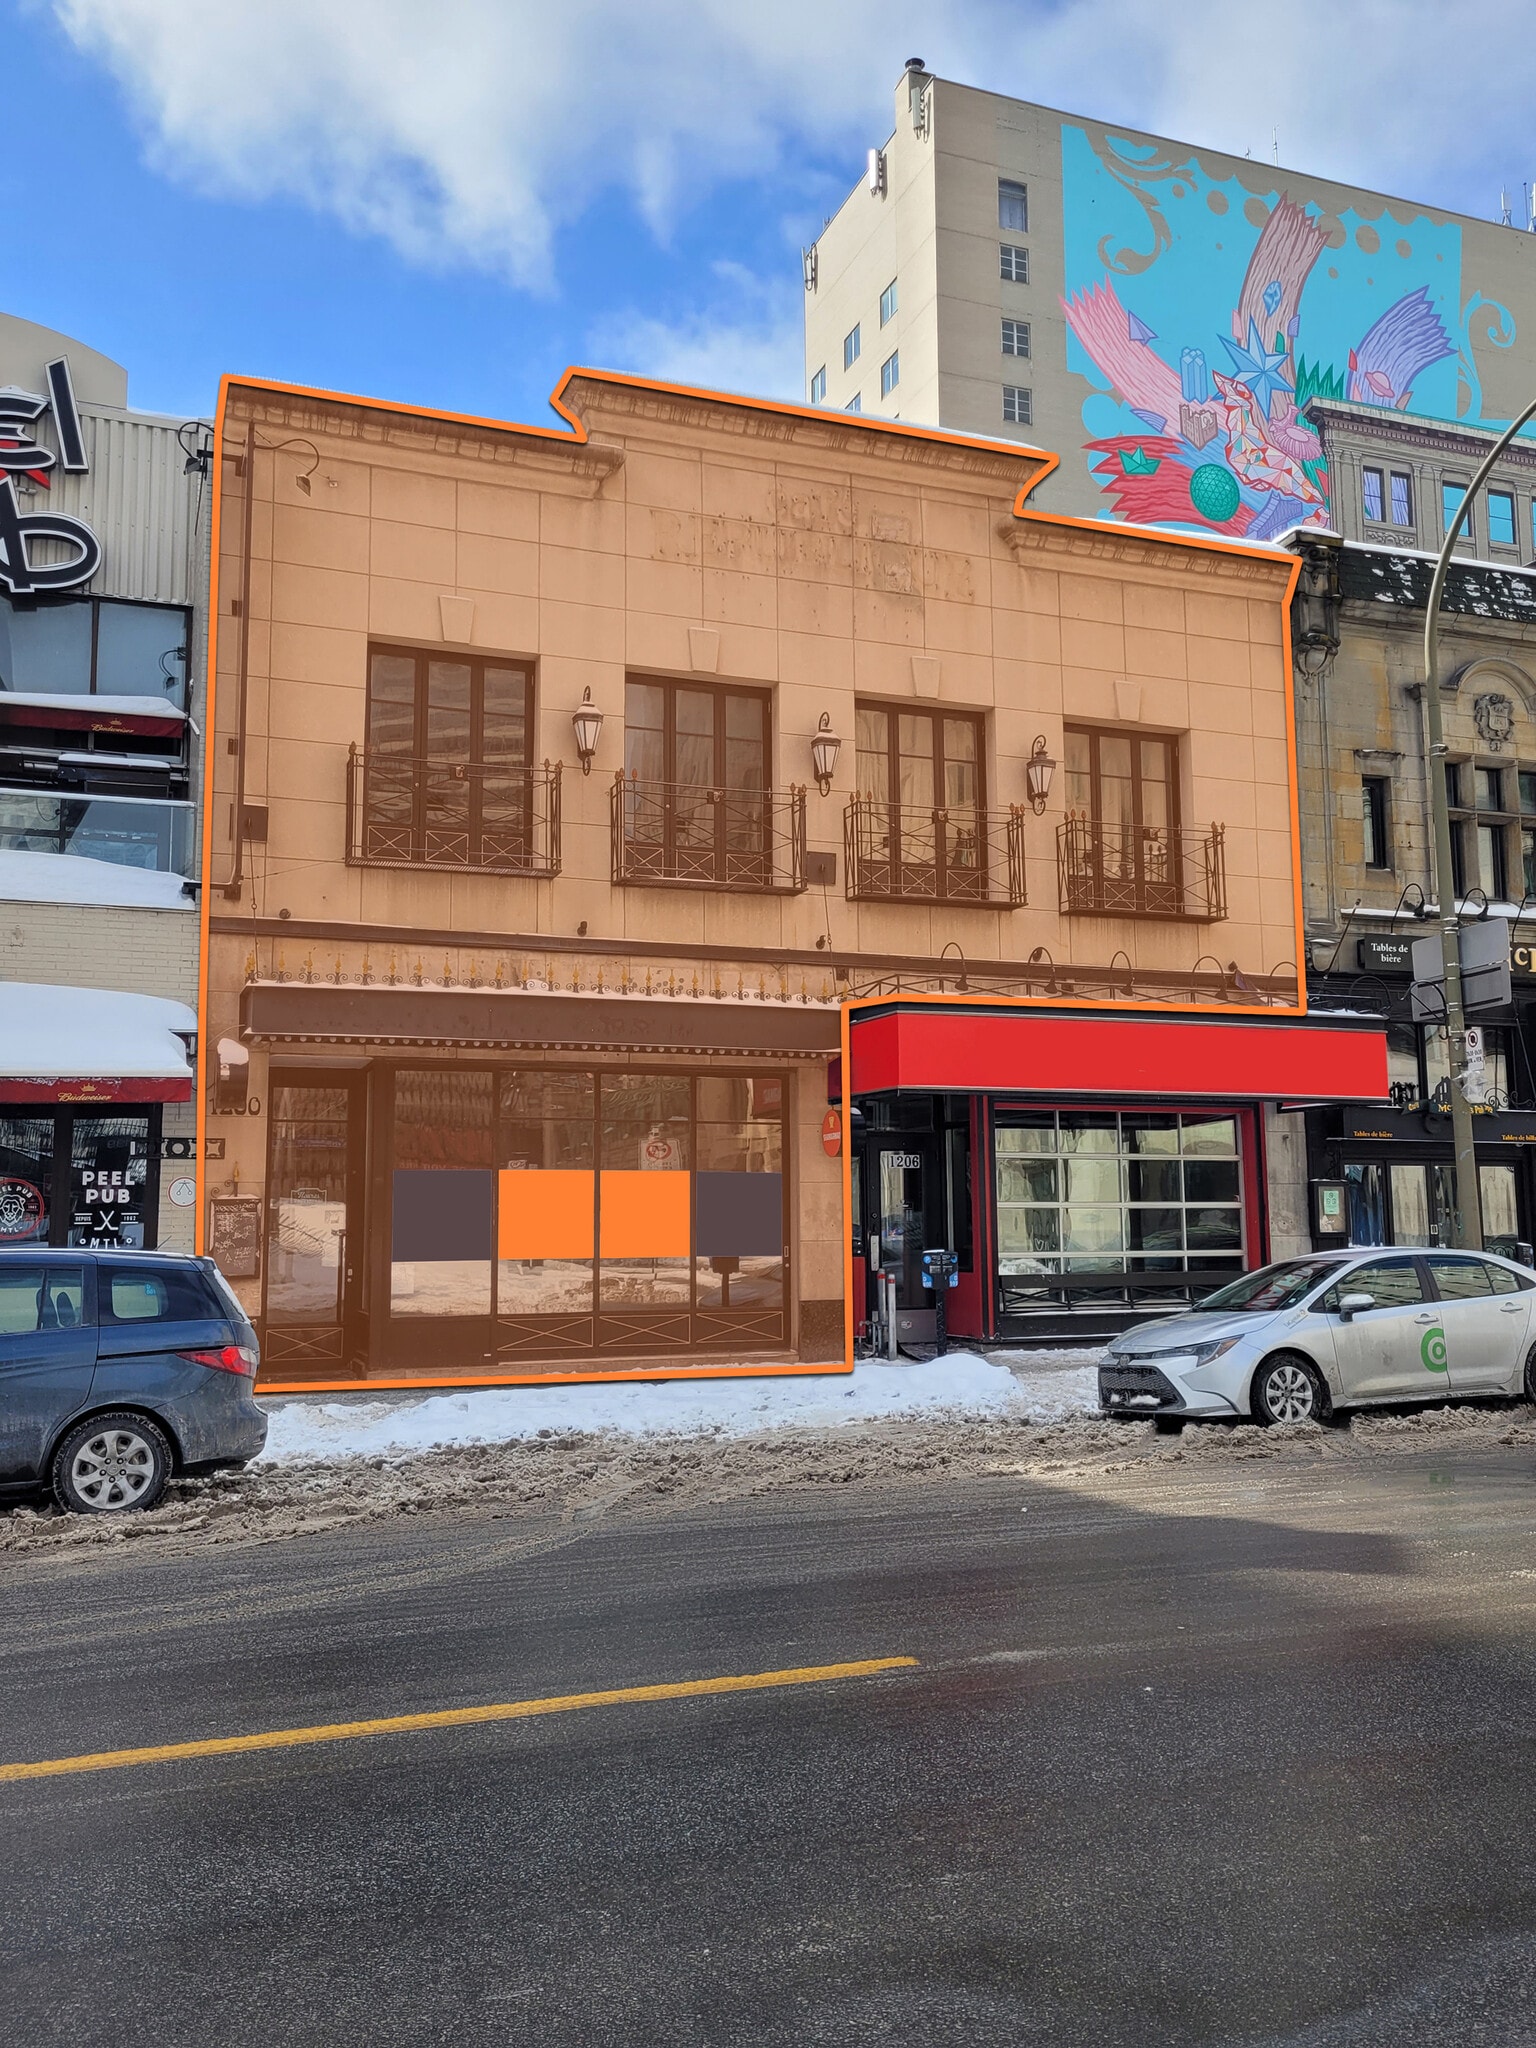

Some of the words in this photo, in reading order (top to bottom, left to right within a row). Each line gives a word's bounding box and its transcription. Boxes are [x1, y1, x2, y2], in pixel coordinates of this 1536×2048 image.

[91, 723, 135, 734] Budweiser
[1370, 943, 1397, 953] Tables
[1398, 943, 1409, 953] de
[1380, 953, 1402, 963] bière
[58, 1092, 113, 1102] Budweiser
[890, 1155, 920, 1168] 1206
[82, 1170, 136, 1186] PEEL
[16, 1185, 33, 1199] PUB
[85, 1188, 131, 1204] PUB
[89, 1237, 121, 1249] MTL
